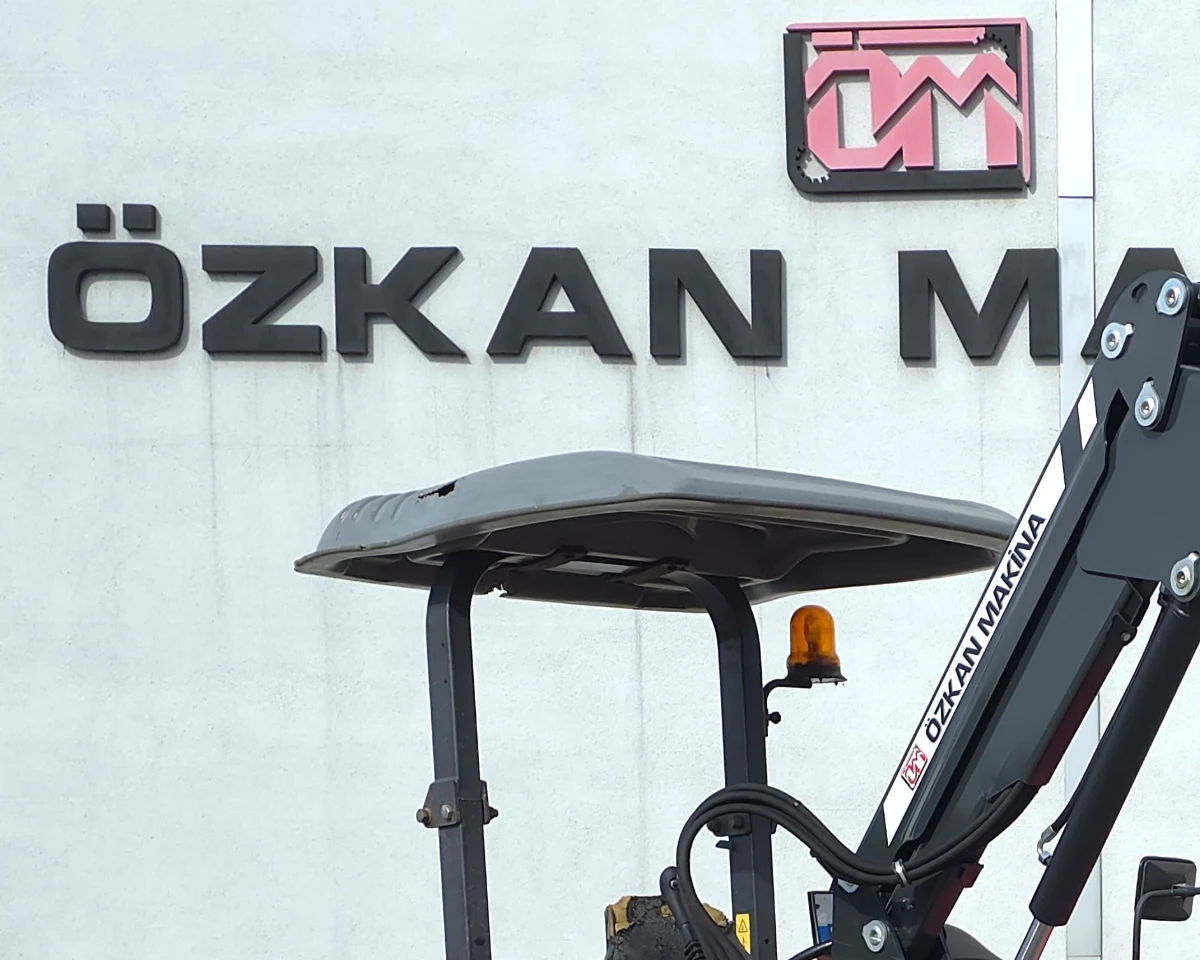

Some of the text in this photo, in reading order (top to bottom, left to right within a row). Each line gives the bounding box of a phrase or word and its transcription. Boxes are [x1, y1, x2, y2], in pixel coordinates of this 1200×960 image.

[48, 203, 785, 361] ÖZKAN
[925, 514, 1046, 743] ÖZKAN MAKİNA
